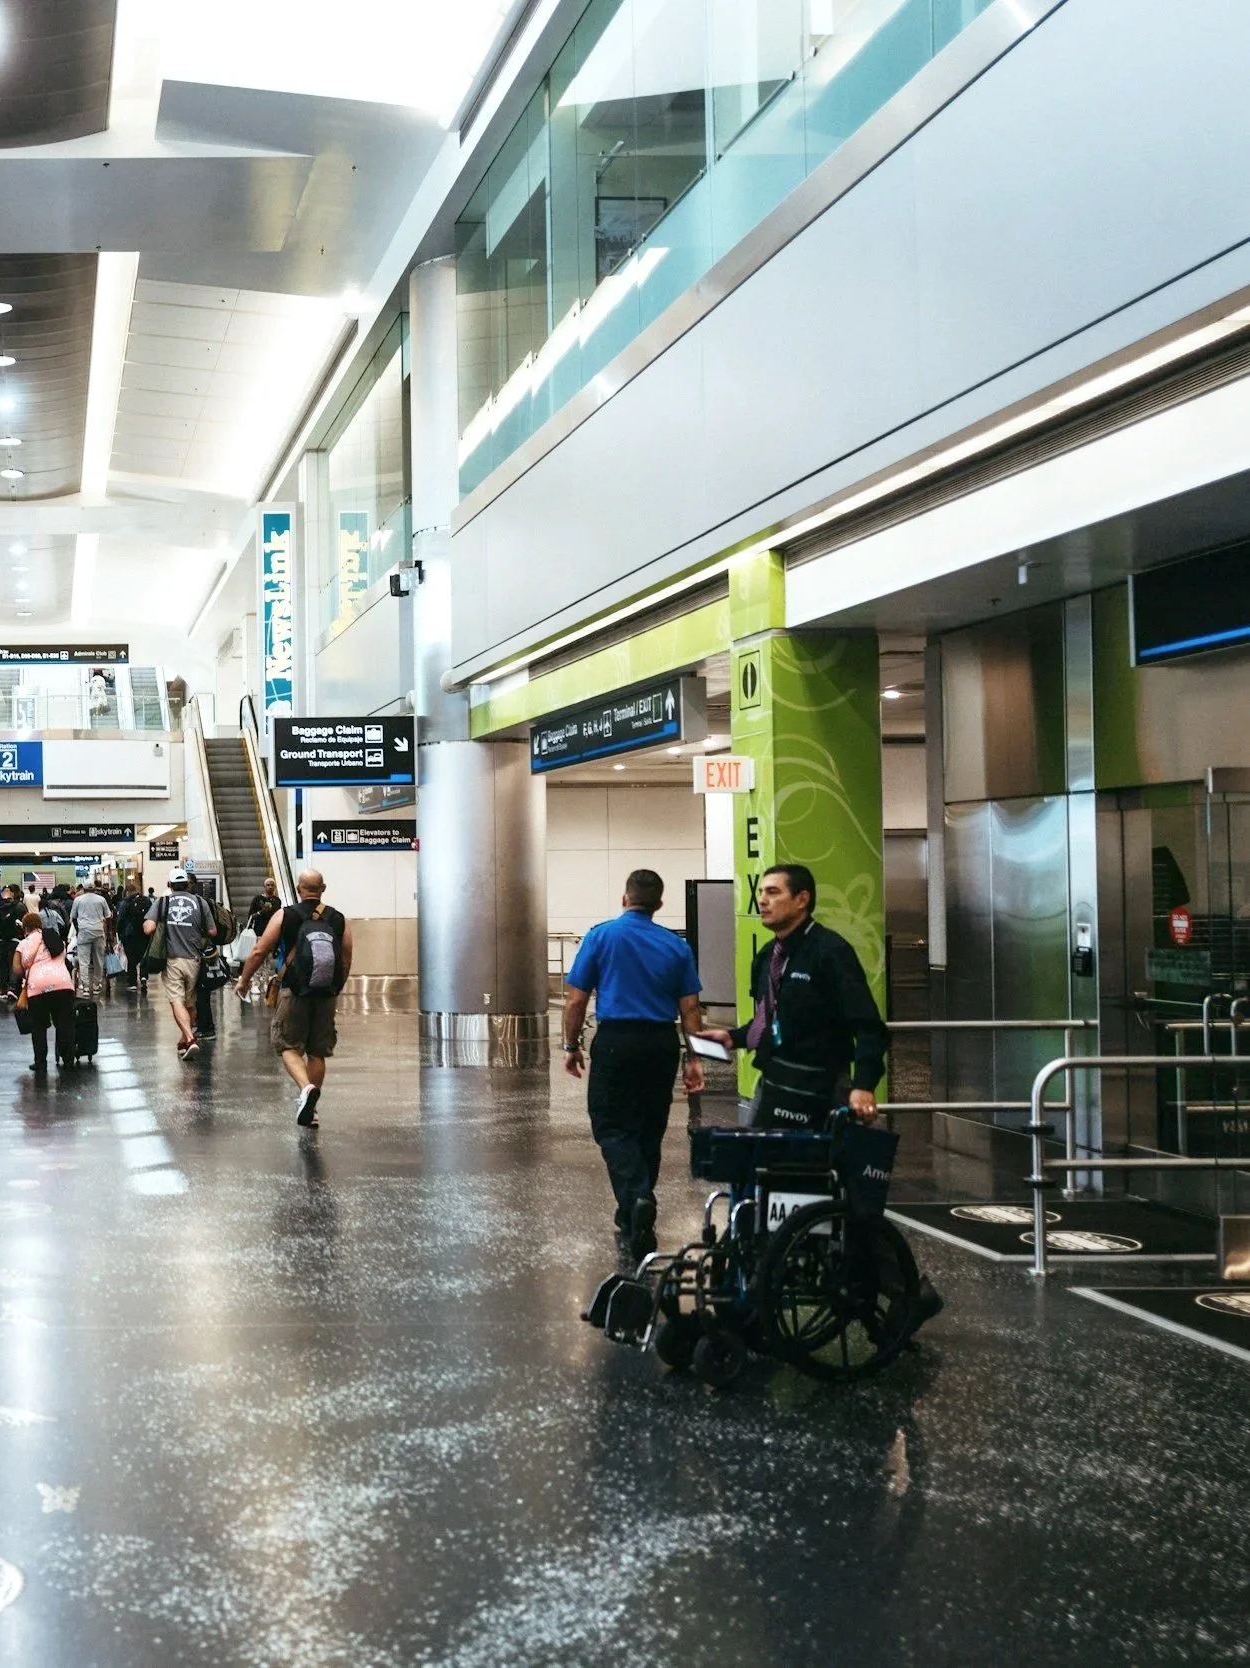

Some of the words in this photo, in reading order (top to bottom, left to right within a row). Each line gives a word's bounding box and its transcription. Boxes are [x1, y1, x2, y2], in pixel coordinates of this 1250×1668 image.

[614, 703, 636, 722] Terminal
[639, 696, 652, 714] EXIT
[291, 726, 334, 737] Baggage
[335, 725, 363, 735] Claim
[548, 729, 565, 744] Baggage
[565, 723, 578, 737] Claim
[337, 736, 363, 745] Equipaje
[2, 751, 14, 768] 2
[280, 750, 316, 759] Ground
[318, 749, 363, 761] Transport
[341, 759, 363, 767] Urbano
[706, 762, 741, 788] EXIT
[97, 827, 122, 837] skytrain
[360, 837, 389, 845] Baggage
[391, 836, 411, 844] Claim
[773, 1106, 811, 1124] envoy
[769, 1202, 786, 1221] AA
